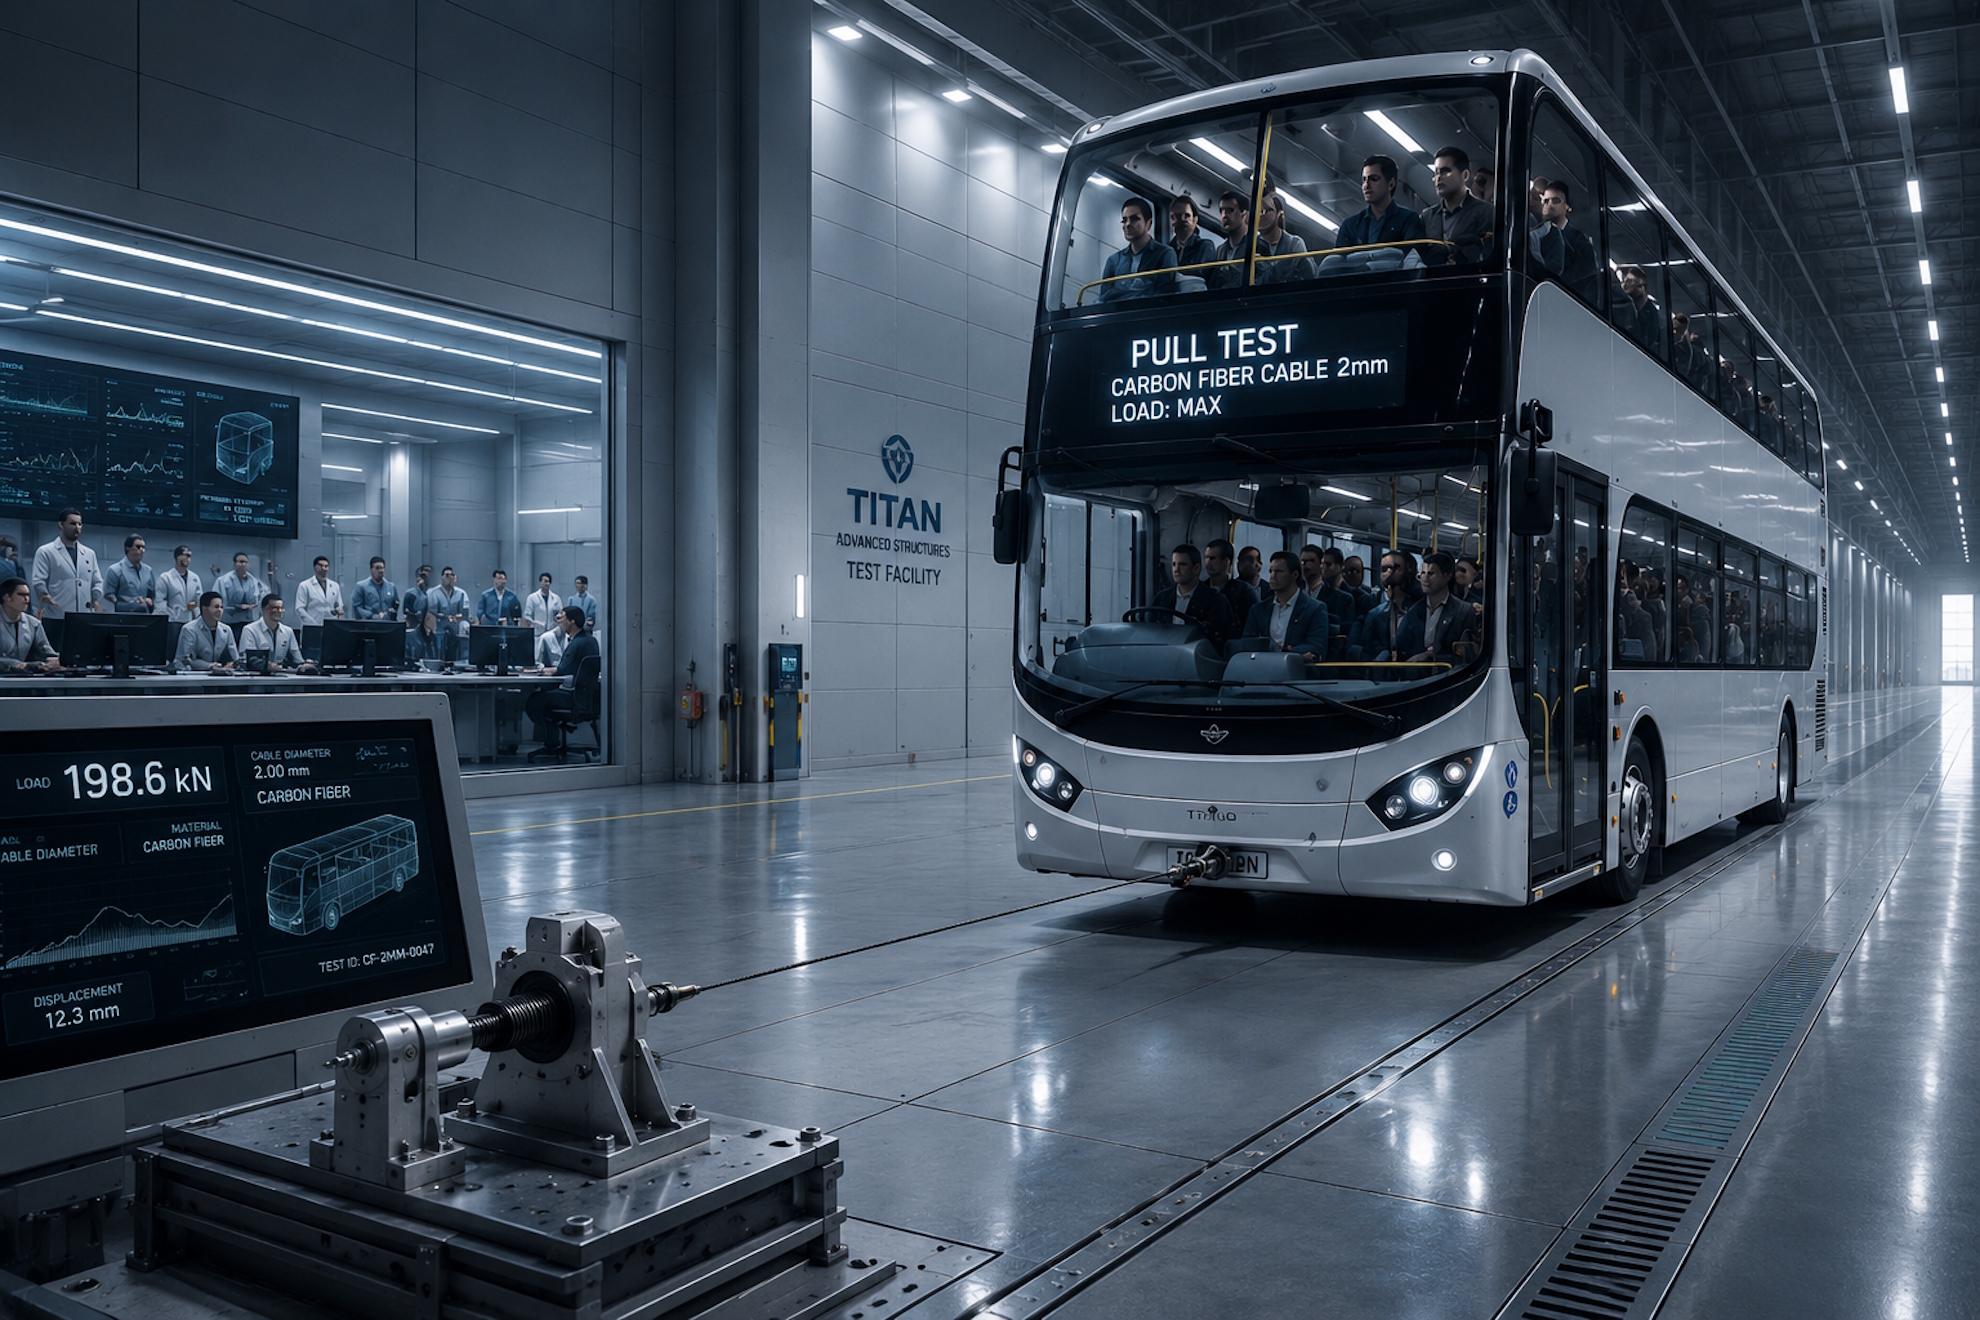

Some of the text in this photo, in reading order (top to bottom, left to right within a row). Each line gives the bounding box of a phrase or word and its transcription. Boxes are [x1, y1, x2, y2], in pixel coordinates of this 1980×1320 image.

[1132, 324, 1299, 368] PULL TEST
[1111, 357, 1388, 397] CARBON FIBER CABLE 2mm
[1111, 395, 1222, 423] LOAD: MAX
[846, 487, 941, 533] TITAN
[836, 532, 950, 558] ADVANCED STRUCTURES
[846, 560, 941, 586] TEST FACILITY
[250, 748, 331, 761] CABLE DIAMETER
[16, 761, 212, 799] LOAD 198.6 kN
[253, 764, 310, 779] 2.00 mm
[257, 787, 311, 804] CARBON
[171, 821, 222, 834] MATERIAL
[36, 844, 98, 860] DIAMETER
[143, 837, 192, 853] CARBON
[318, 943, 435, 973] TEST ID: CF-2MM-0047
[33, 982, 123, 1008] DISPLACEMENT
[45, 1004, 120, 1029] 12.3 mm
